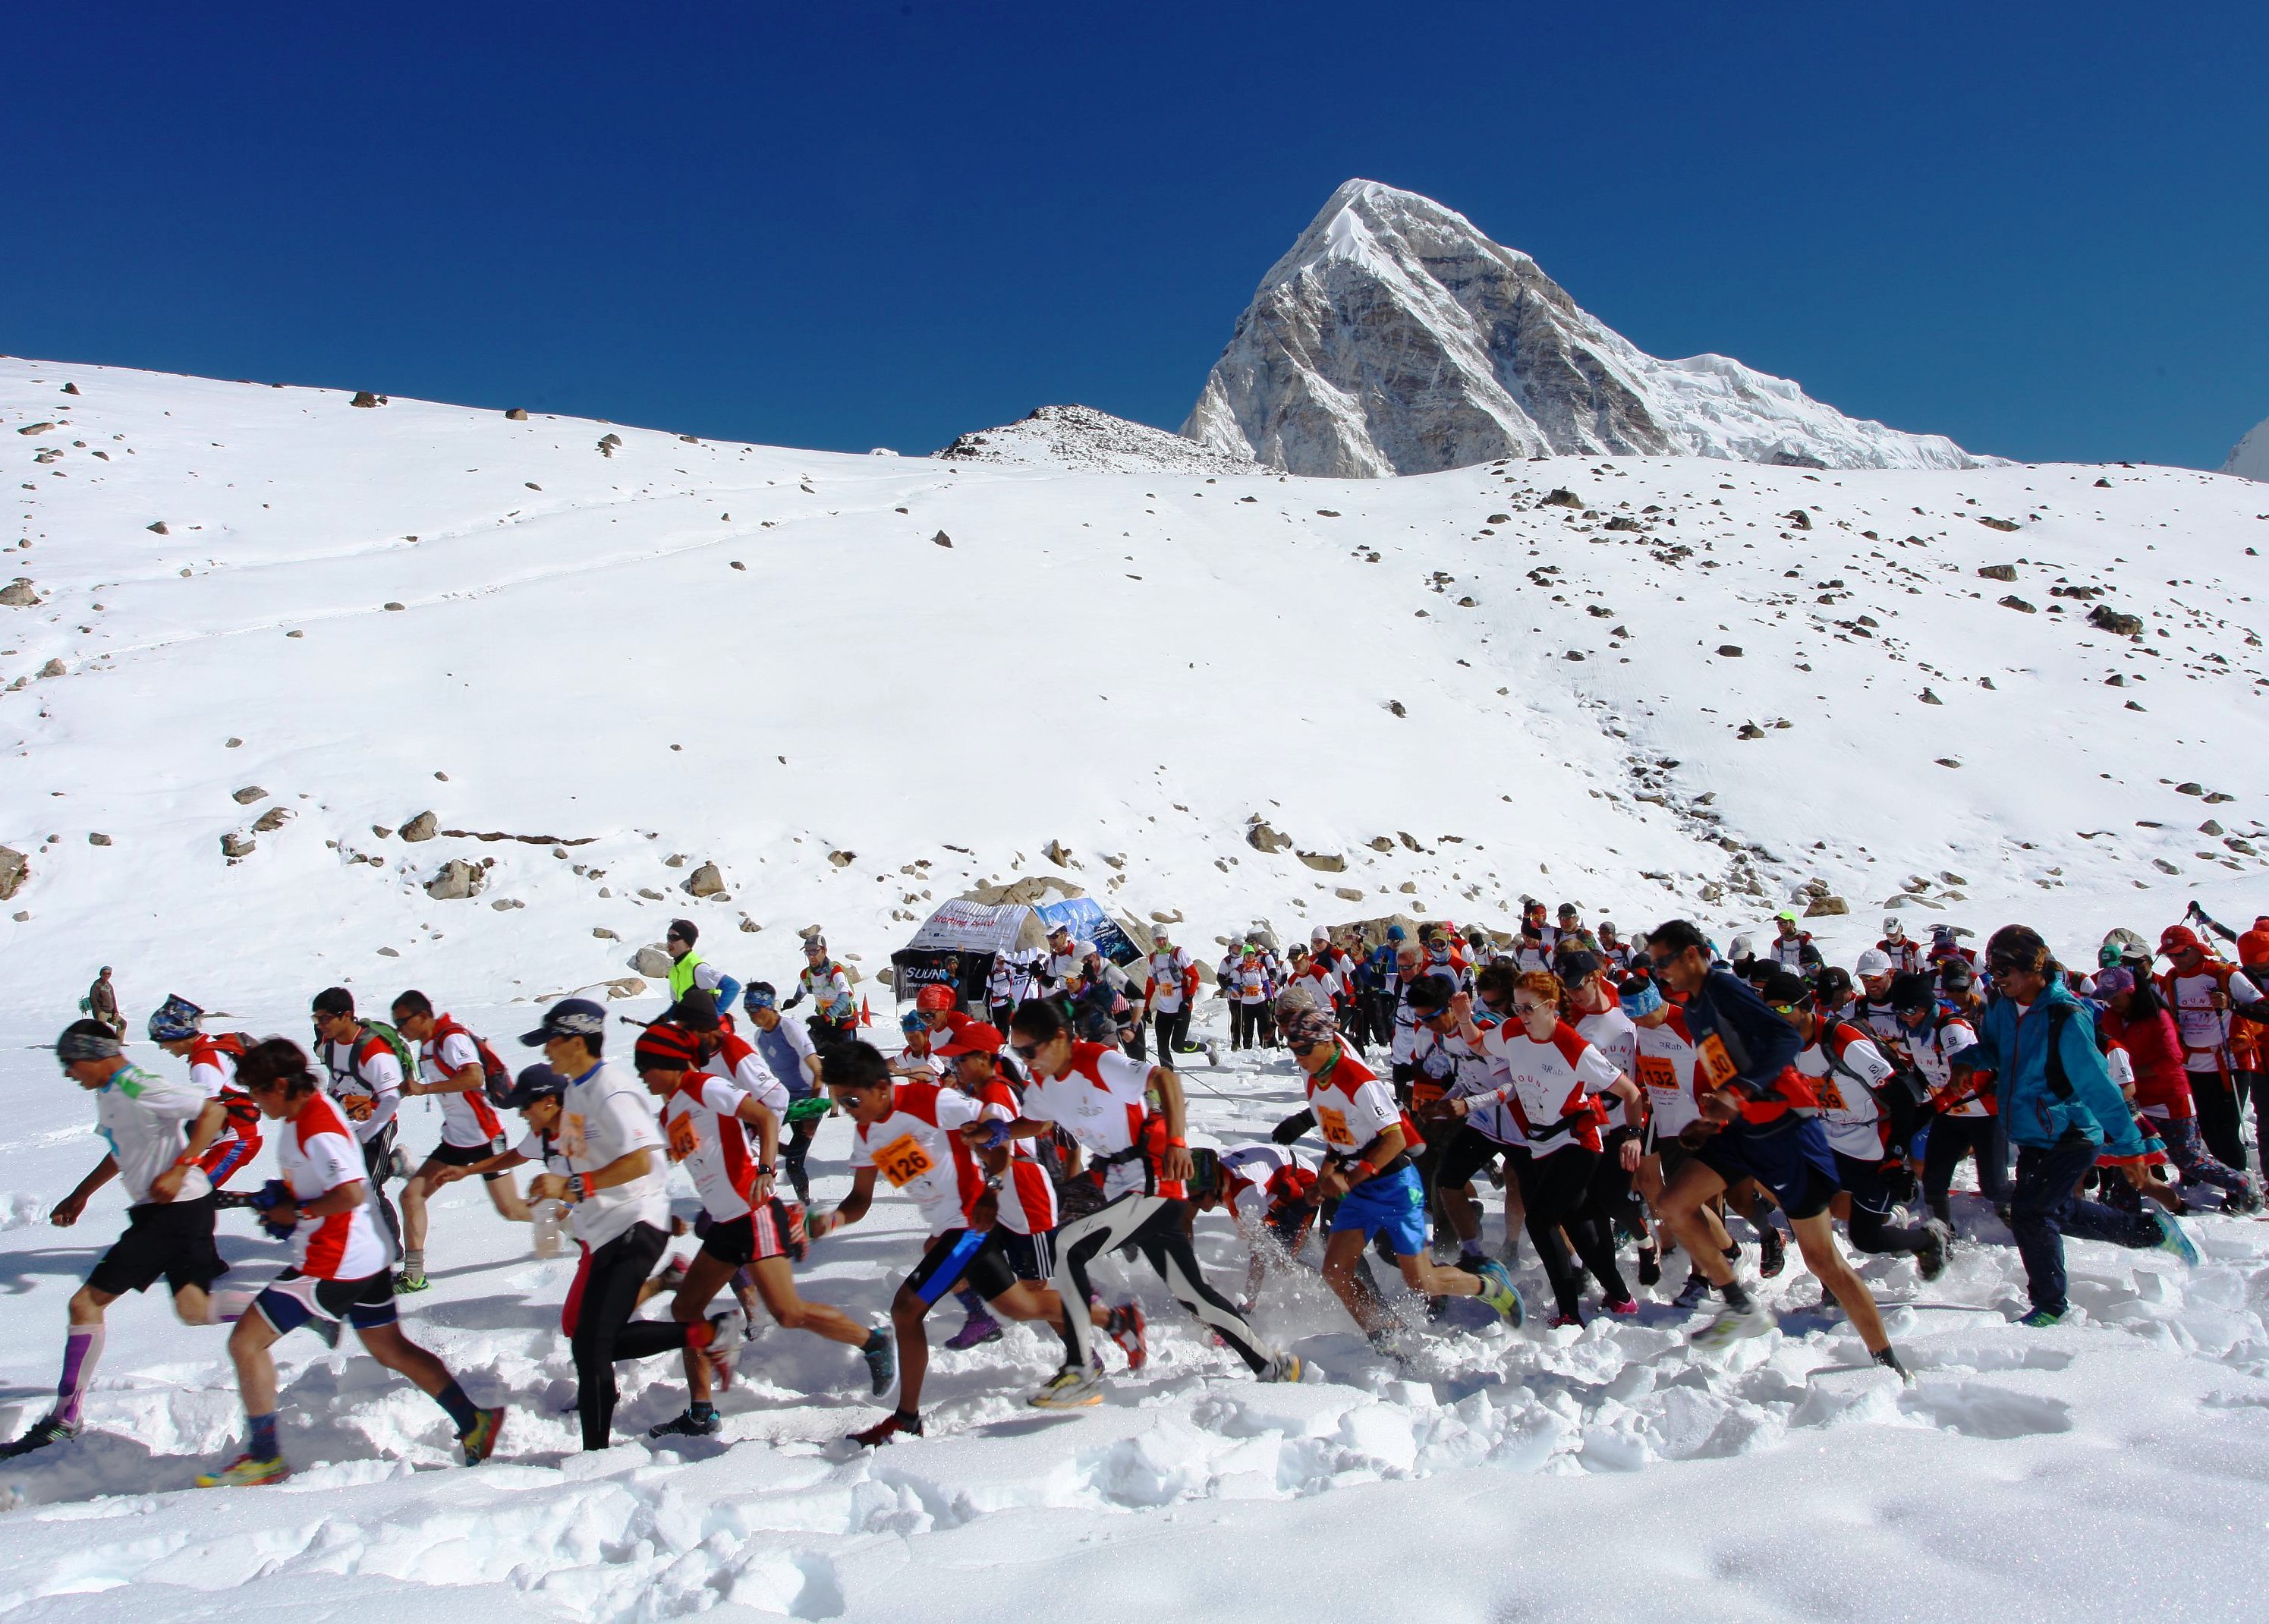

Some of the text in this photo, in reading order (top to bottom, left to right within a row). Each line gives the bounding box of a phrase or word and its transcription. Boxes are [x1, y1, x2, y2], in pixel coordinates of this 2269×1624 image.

[1513, 1075, 1550, 1094] OUNT
[1645, 1070, 1676, 1087] 132
[889, 1150, 928, 1182] 126
